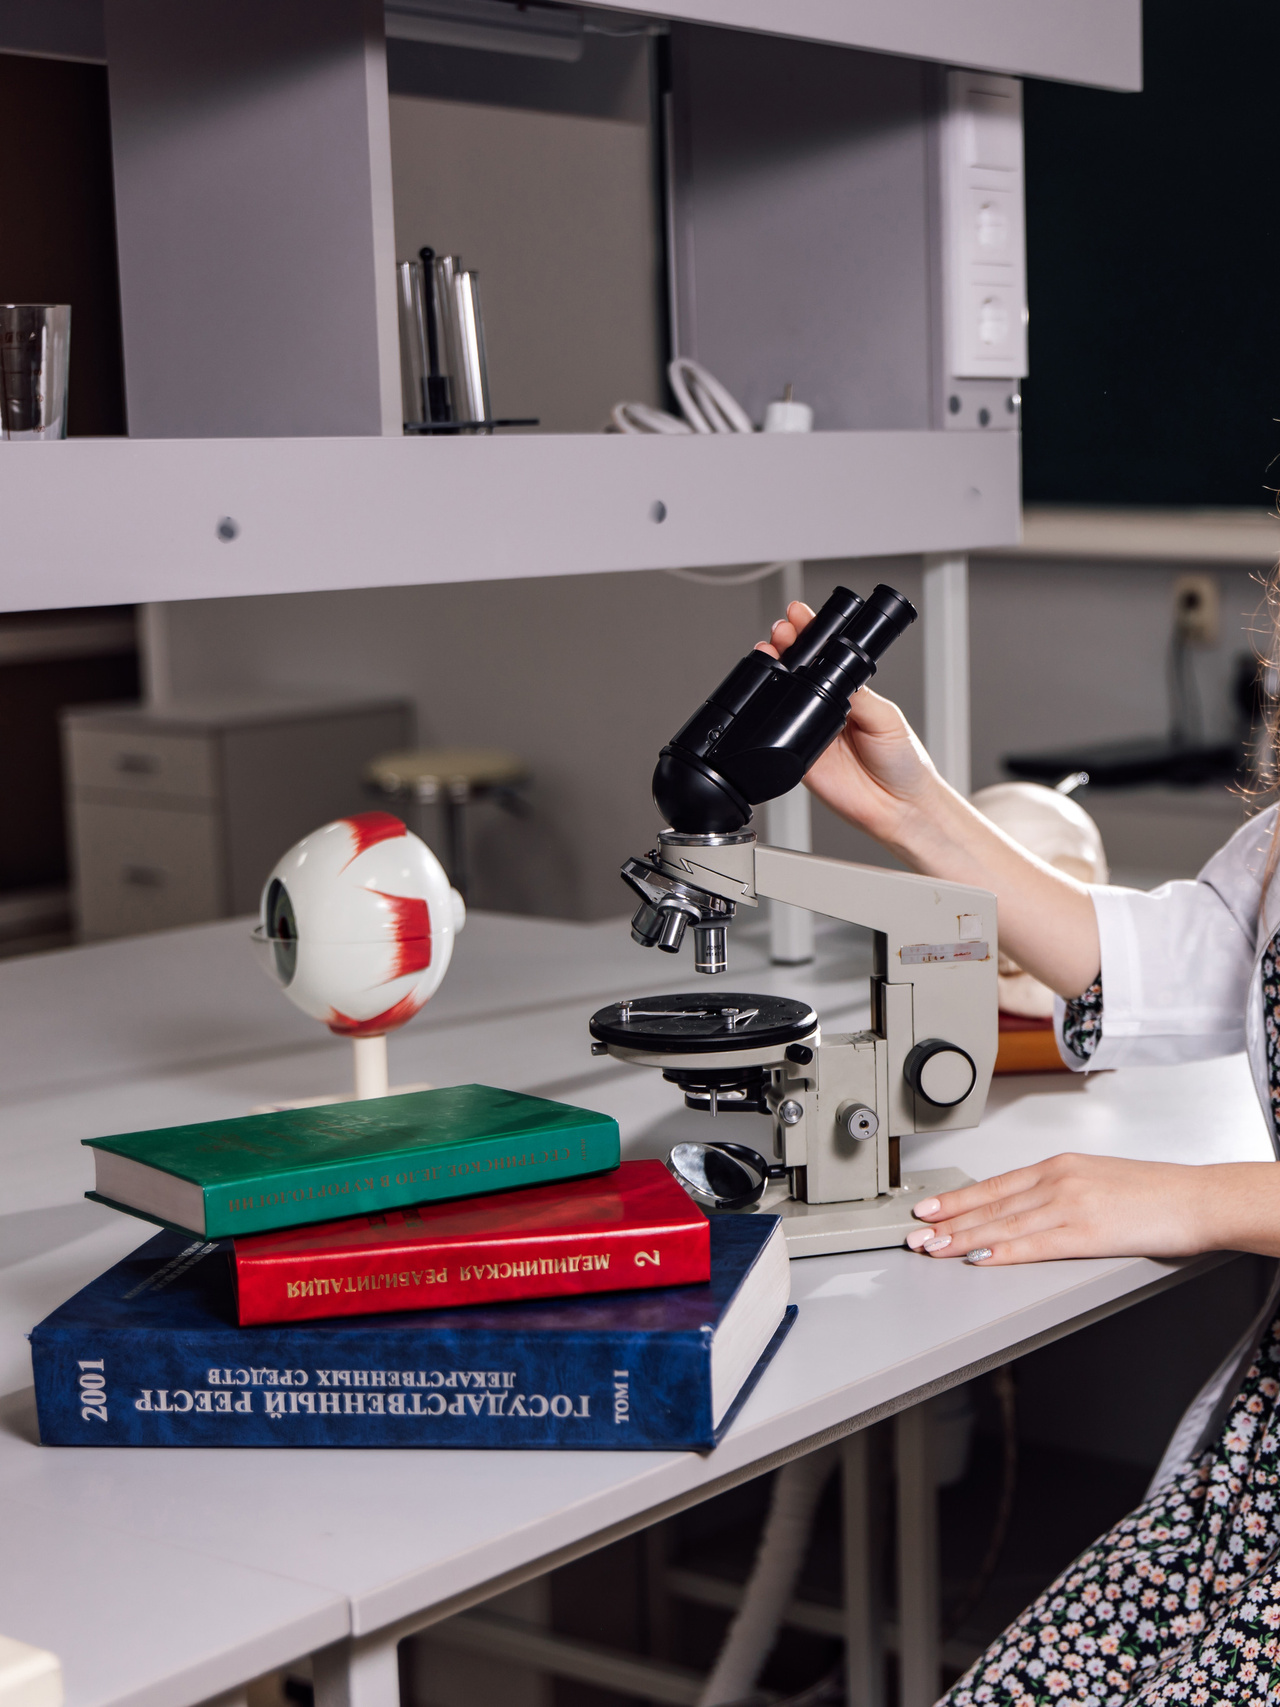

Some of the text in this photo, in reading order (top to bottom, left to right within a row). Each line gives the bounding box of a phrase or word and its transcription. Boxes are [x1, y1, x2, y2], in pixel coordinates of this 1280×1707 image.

[396, 1166, 442, 1185] ДЕЛО
[447, 1147, 571, 1178] СЕСТРИНСКОЕ
[228, 1177, 374, 1213] КУРОРТОЛОГИИ
[380, 1175, 390, 1187] В
[634, 1249, 661, 1266] 2
[286, 1252, 611, 1299] МЕДИЦИНСКАЯ РЕАБИЛИТАЦИЯ
[77, 1358, 108, 1423] 2001
[208, 1367, 517, 1388] ЛЕКАРСТВЕННЫХ СРЕДСТВ
[135, 1390, 592, 1419] ГОСУДАРСТВЕННЫЙ РЕЕСТР
[613, 1370, 630, 1424] ТОМ I
